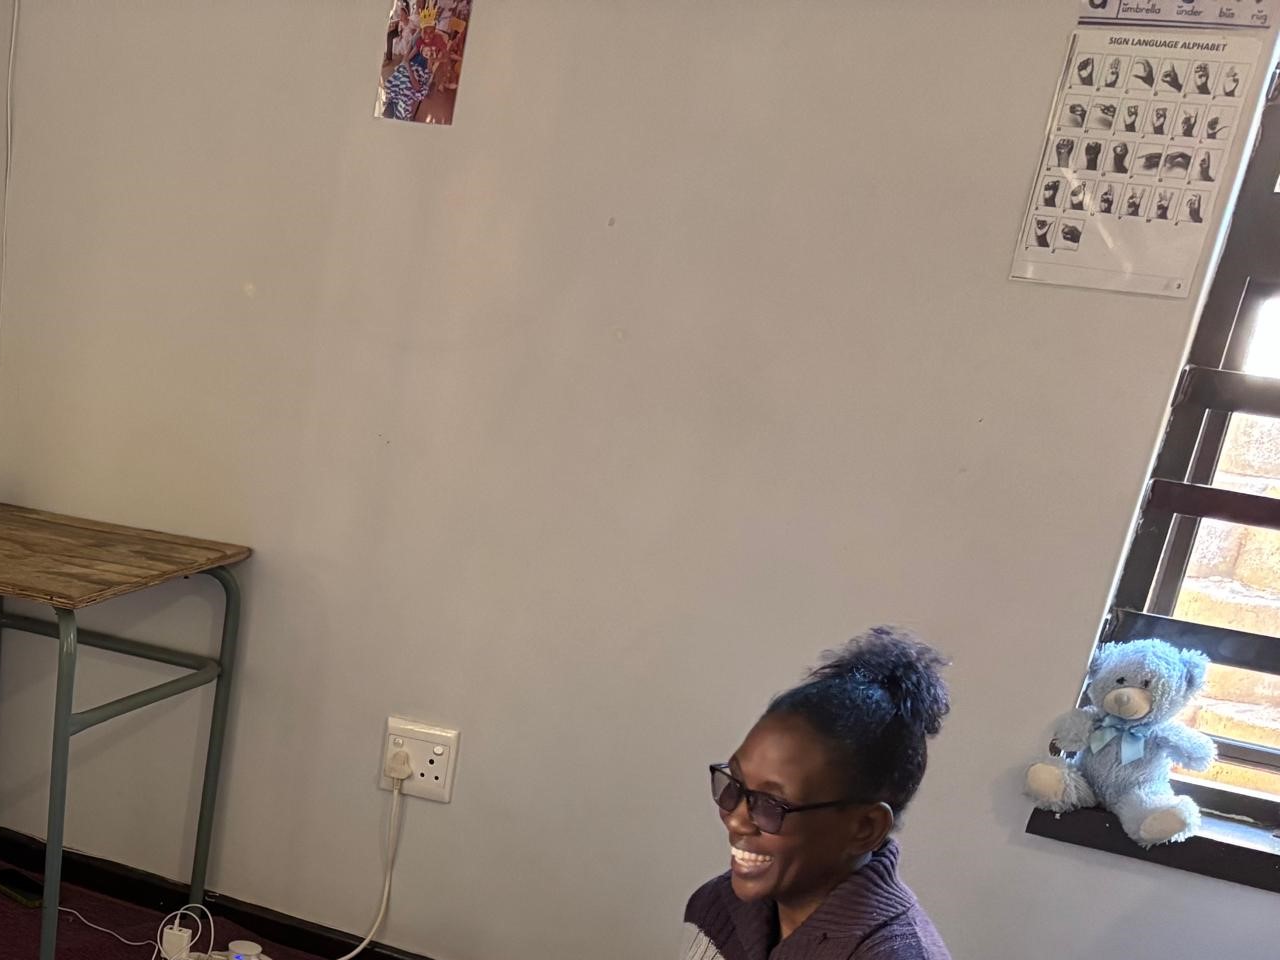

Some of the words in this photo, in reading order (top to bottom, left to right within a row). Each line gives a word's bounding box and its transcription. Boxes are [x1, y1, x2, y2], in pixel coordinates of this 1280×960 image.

[1108, 36, 1129, 46] SIGN
[1130, 38, 1180, 50] LANGUAGE
[1180, 41, 1228, 52] ALPHABET
